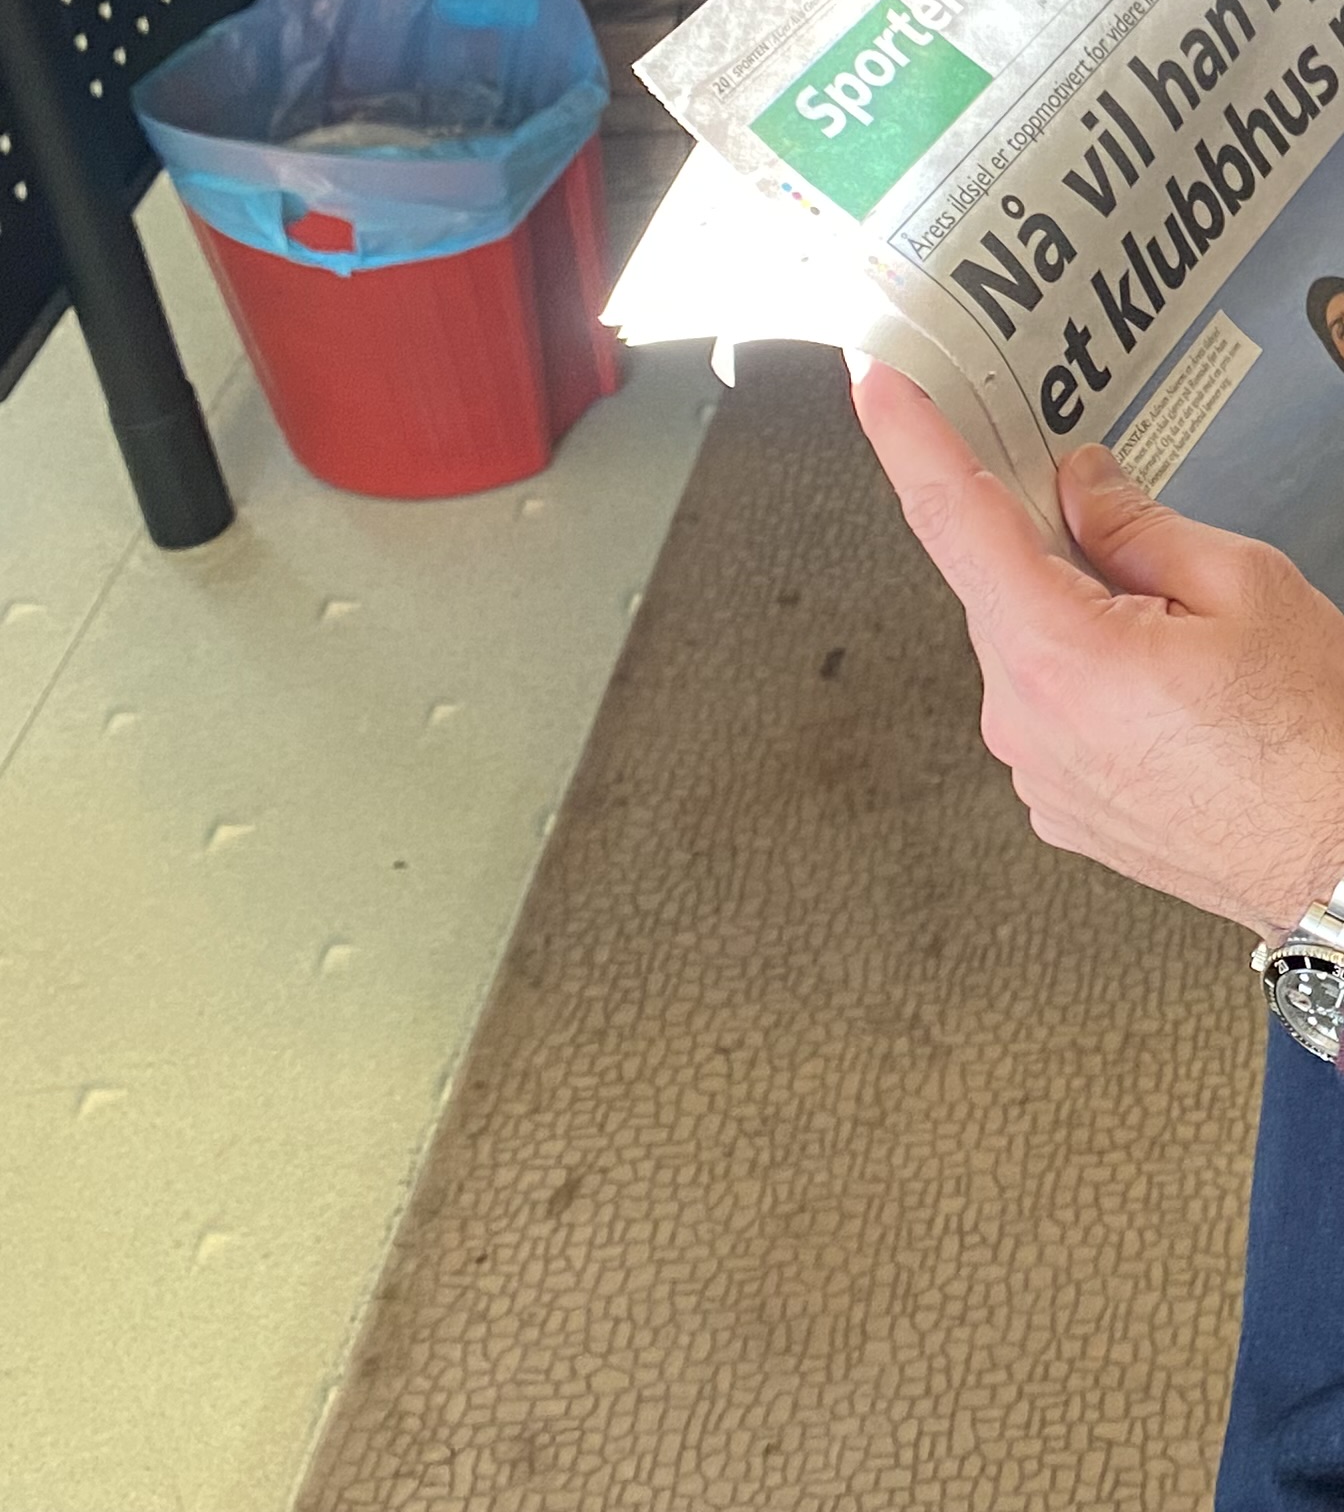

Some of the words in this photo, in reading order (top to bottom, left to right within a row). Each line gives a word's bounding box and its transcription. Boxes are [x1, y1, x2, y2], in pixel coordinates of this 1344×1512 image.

[711, 75, 731, 95] 20
[729, 42, 772, 77] SPORTEN
[901, 208, 956, 260] Årets
[945, 164, 993, 216] ildsjel
[990, 148, 1010, 171] er
[1006, 58, 1094, 151] toppmotivert
[1083, 38, 1109, 65] for
[1105, 0, 1146, 42] videre
[950, 195, 1077, 340] Nå
[1062, 90, 1155, 217] vil
[1040, 317, 1111, 434] et
[1090, 45, 1339, 353] klubbhus
[1273, 960, 1287, 975] 20
